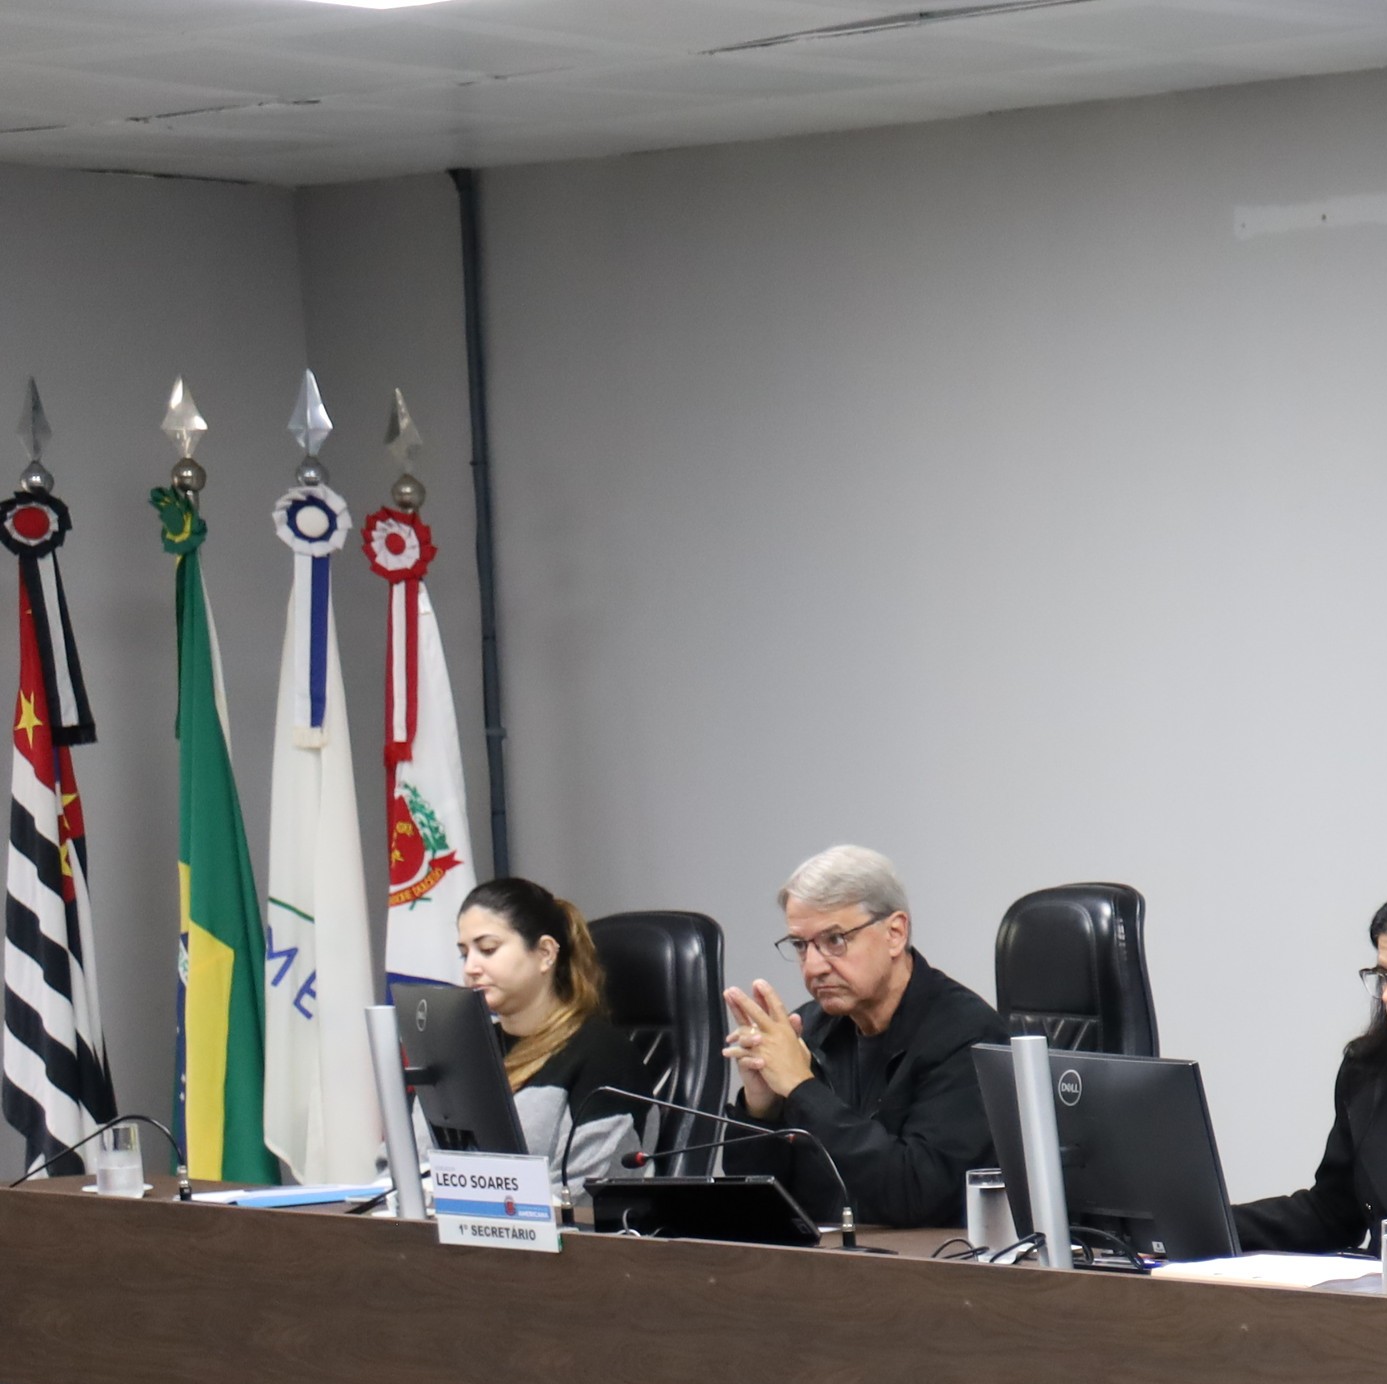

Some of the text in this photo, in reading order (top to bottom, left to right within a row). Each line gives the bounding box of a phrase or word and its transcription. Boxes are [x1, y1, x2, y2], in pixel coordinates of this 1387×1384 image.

[1062, 1083, 1080, 1093] DELL
[436, 1173, 519, 1191] LECO SOARES
[471, 1225, 536, 1241] SECRETÁRIO
